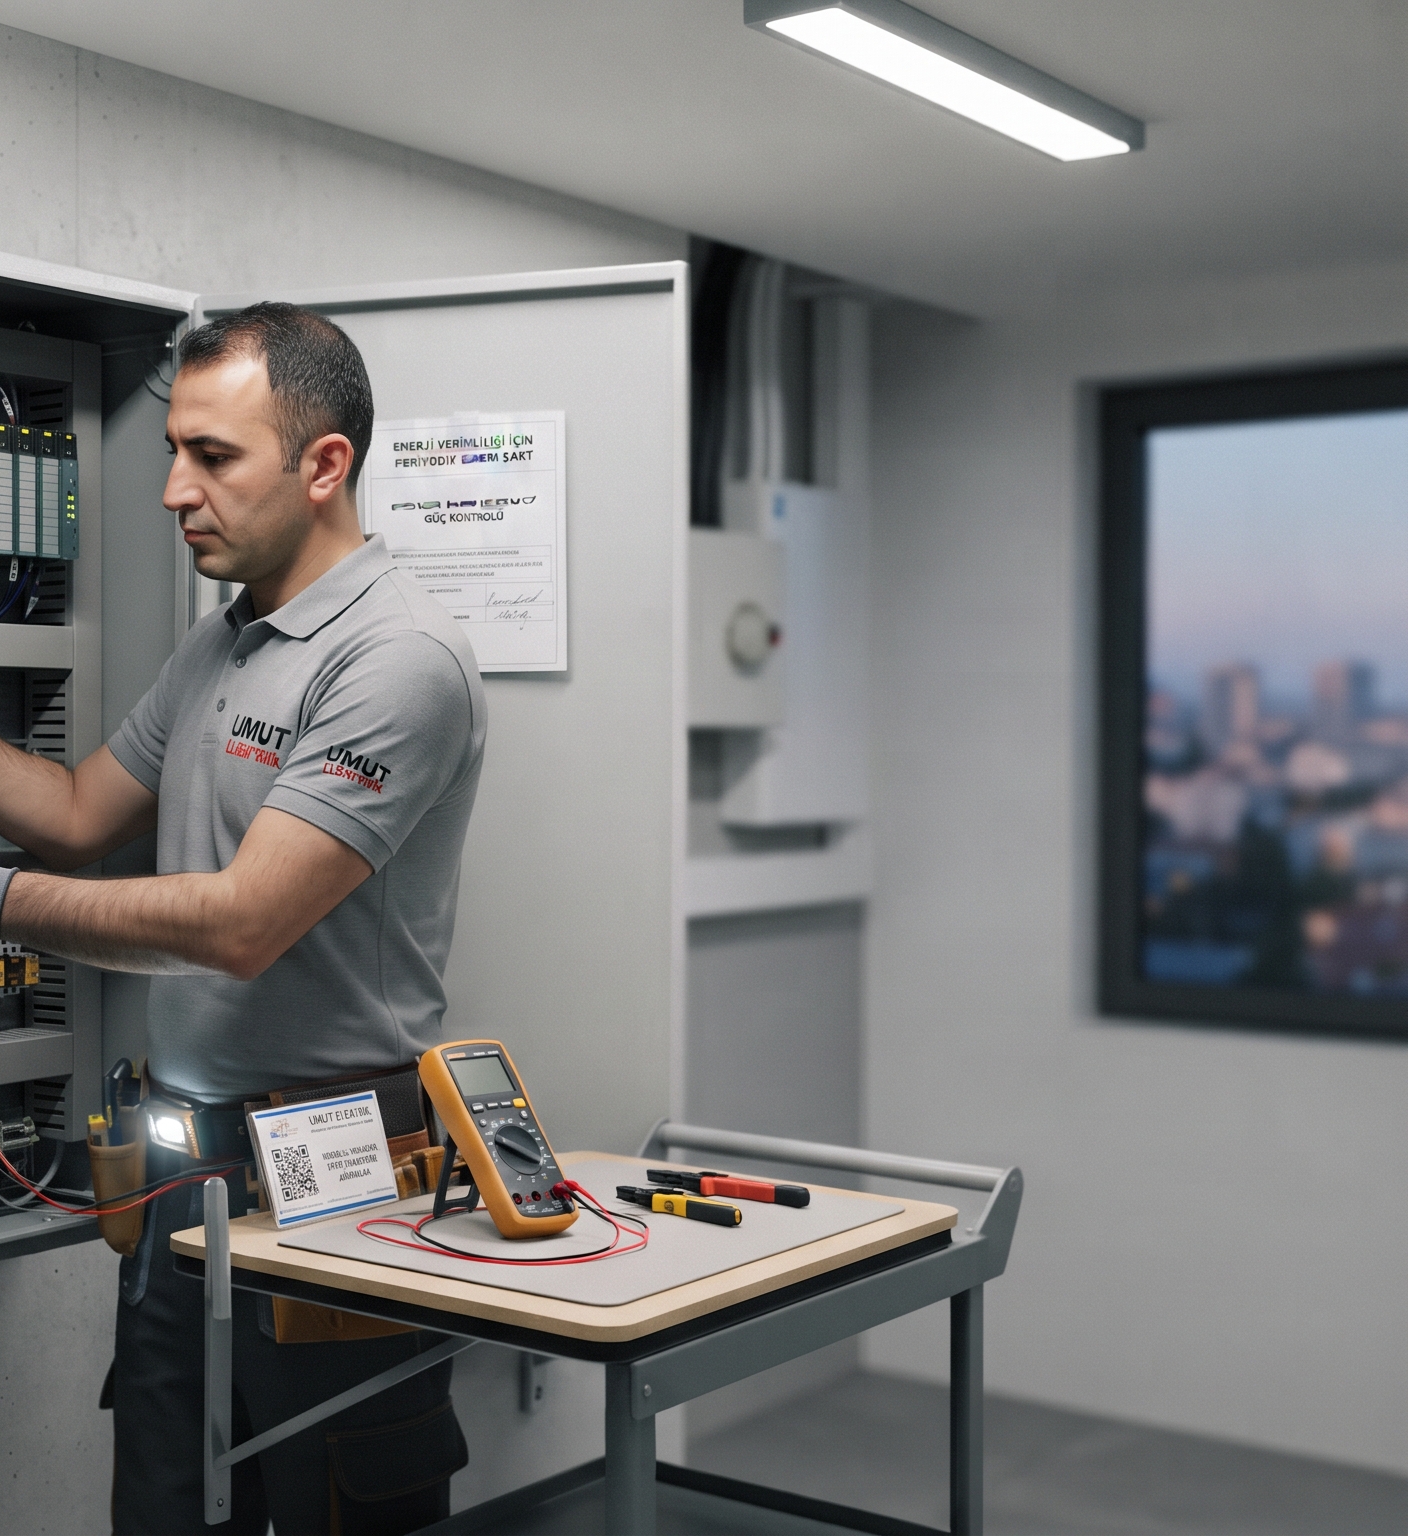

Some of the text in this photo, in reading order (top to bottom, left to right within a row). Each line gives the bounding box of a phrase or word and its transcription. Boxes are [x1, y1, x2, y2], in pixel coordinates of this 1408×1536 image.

[424, 511, 447, 525] GÜÇ
[231, 713, 292, 750] UMUT
[326, 745, 392, 783] UMUT
